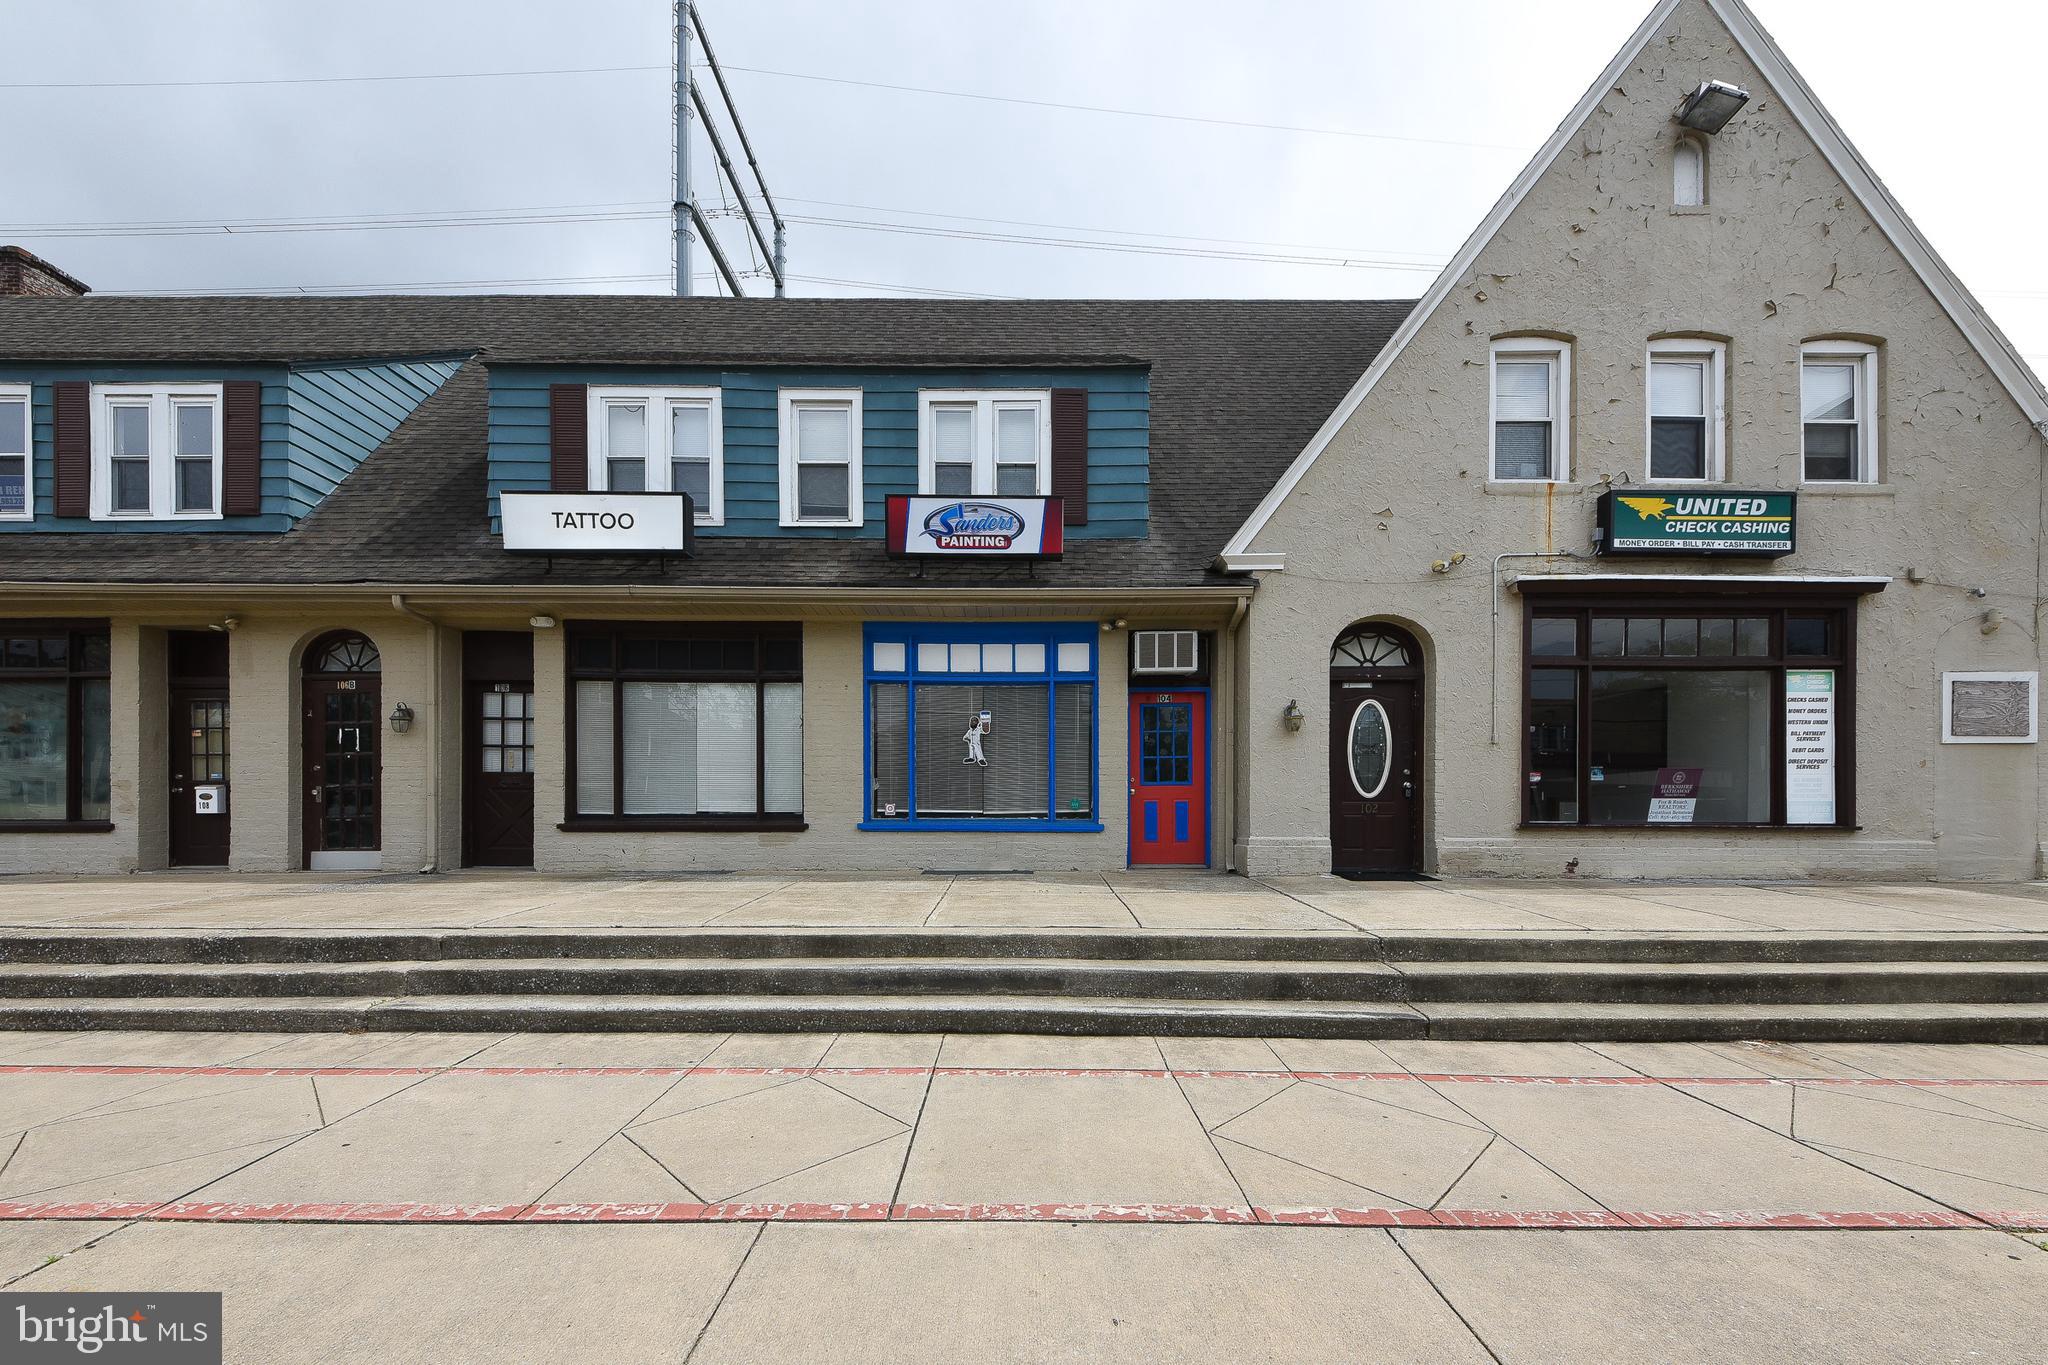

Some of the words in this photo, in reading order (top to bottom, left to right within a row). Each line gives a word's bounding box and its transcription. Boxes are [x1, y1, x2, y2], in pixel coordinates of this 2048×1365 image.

[1675, 497, 1767, 516] UNITED
[551, 512, 634, 530] TATTOO
[919, 502, 1015, 537] Sanders
[1665, 521, 1718, 533] CHECK
[1721, 522, 1791, 534] CASHING
[941, 536, 1006, 547] PAINTING
[1618, 539, 1647, 547] MONEY
[1682, 540, 1700, 548] BILL
[1746, 541, 1788, 549] TRANSFER
[1360, 803, 1379, 814] 102
